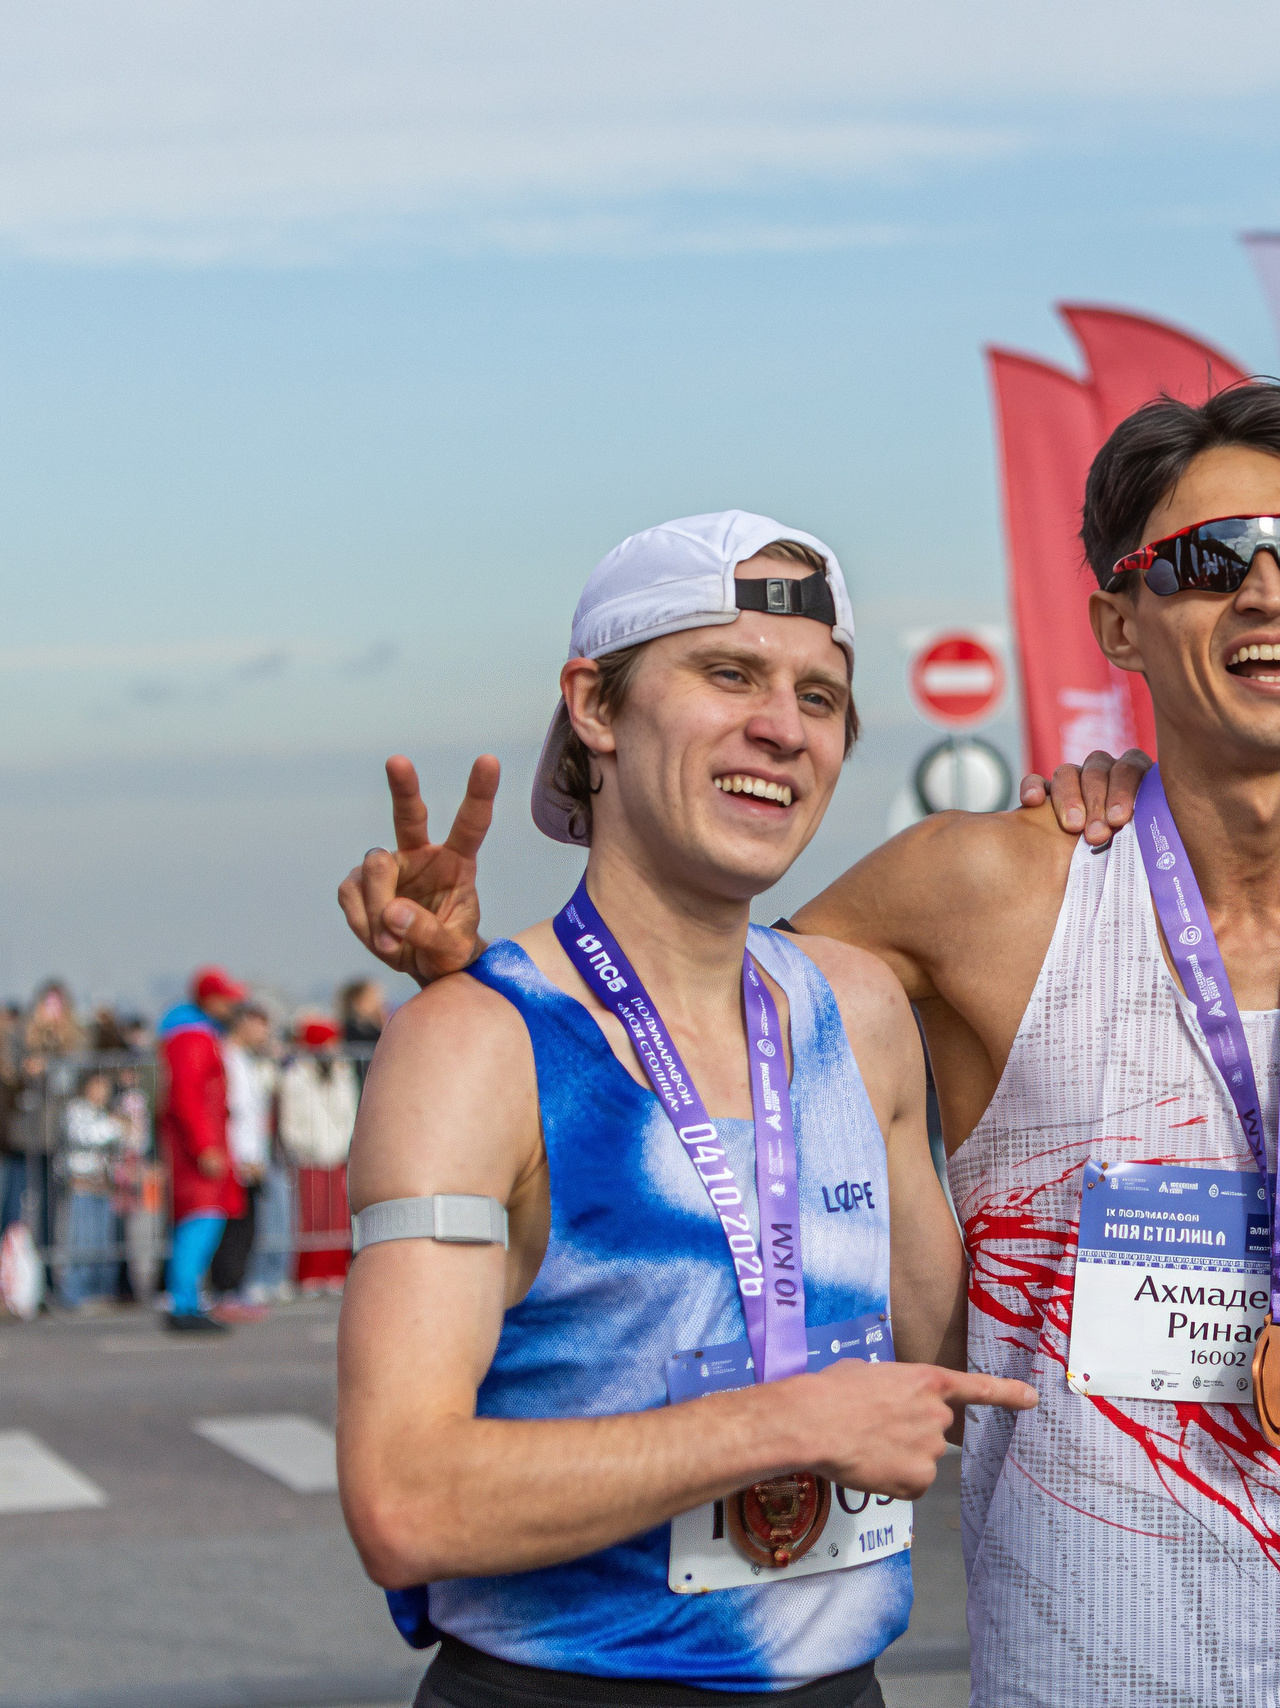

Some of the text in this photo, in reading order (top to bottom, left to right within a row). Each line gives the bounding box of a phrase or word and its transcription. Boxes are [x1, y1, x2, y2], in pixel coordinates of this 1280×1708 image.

[589, 951, 628, 993] ПСБ
[1143, 1225, 1226, 1246] СТОЛИЦА
[774, 1278, 797, 1307] 10
[1190, 1350, 1247, 1367] 16002
